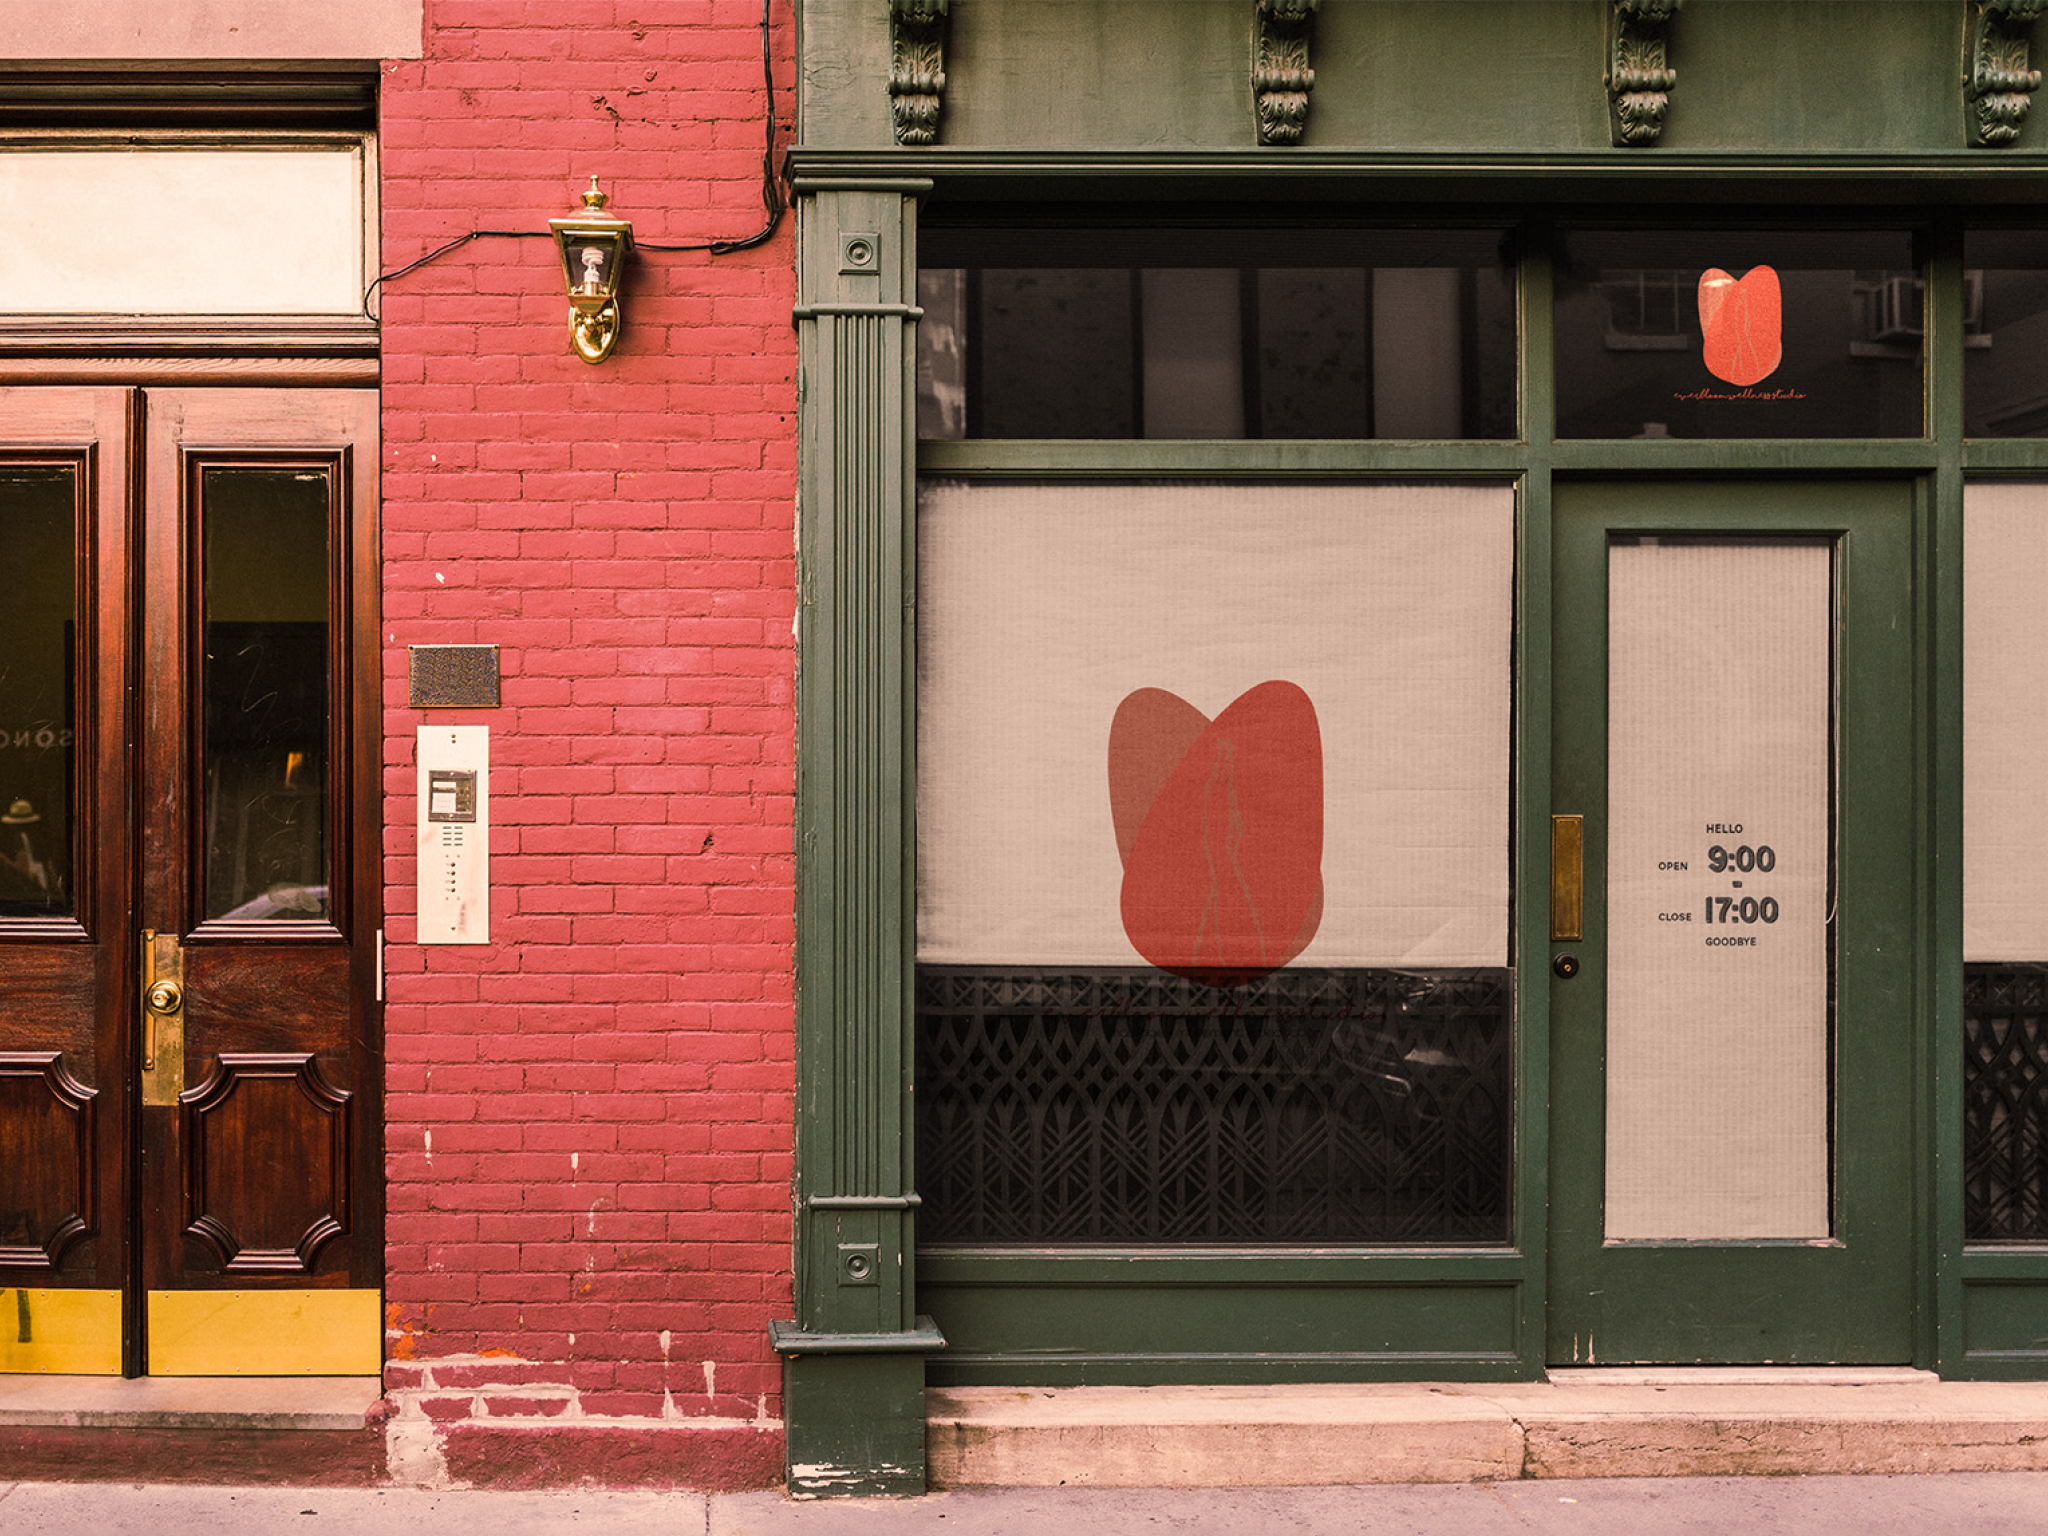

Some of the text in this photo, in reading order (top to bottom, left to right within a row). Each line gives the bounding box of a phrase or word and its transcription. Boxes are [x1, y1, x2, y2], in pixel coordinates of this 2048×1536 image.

[1706, 823, 1744, 834] HELLO
[1658, 844, 1776, 873] OPEN 9:00
[1658, 896, 1779, 924] CLOSE 17:00
[1705, 936, 1757, 947] GOODBYE
